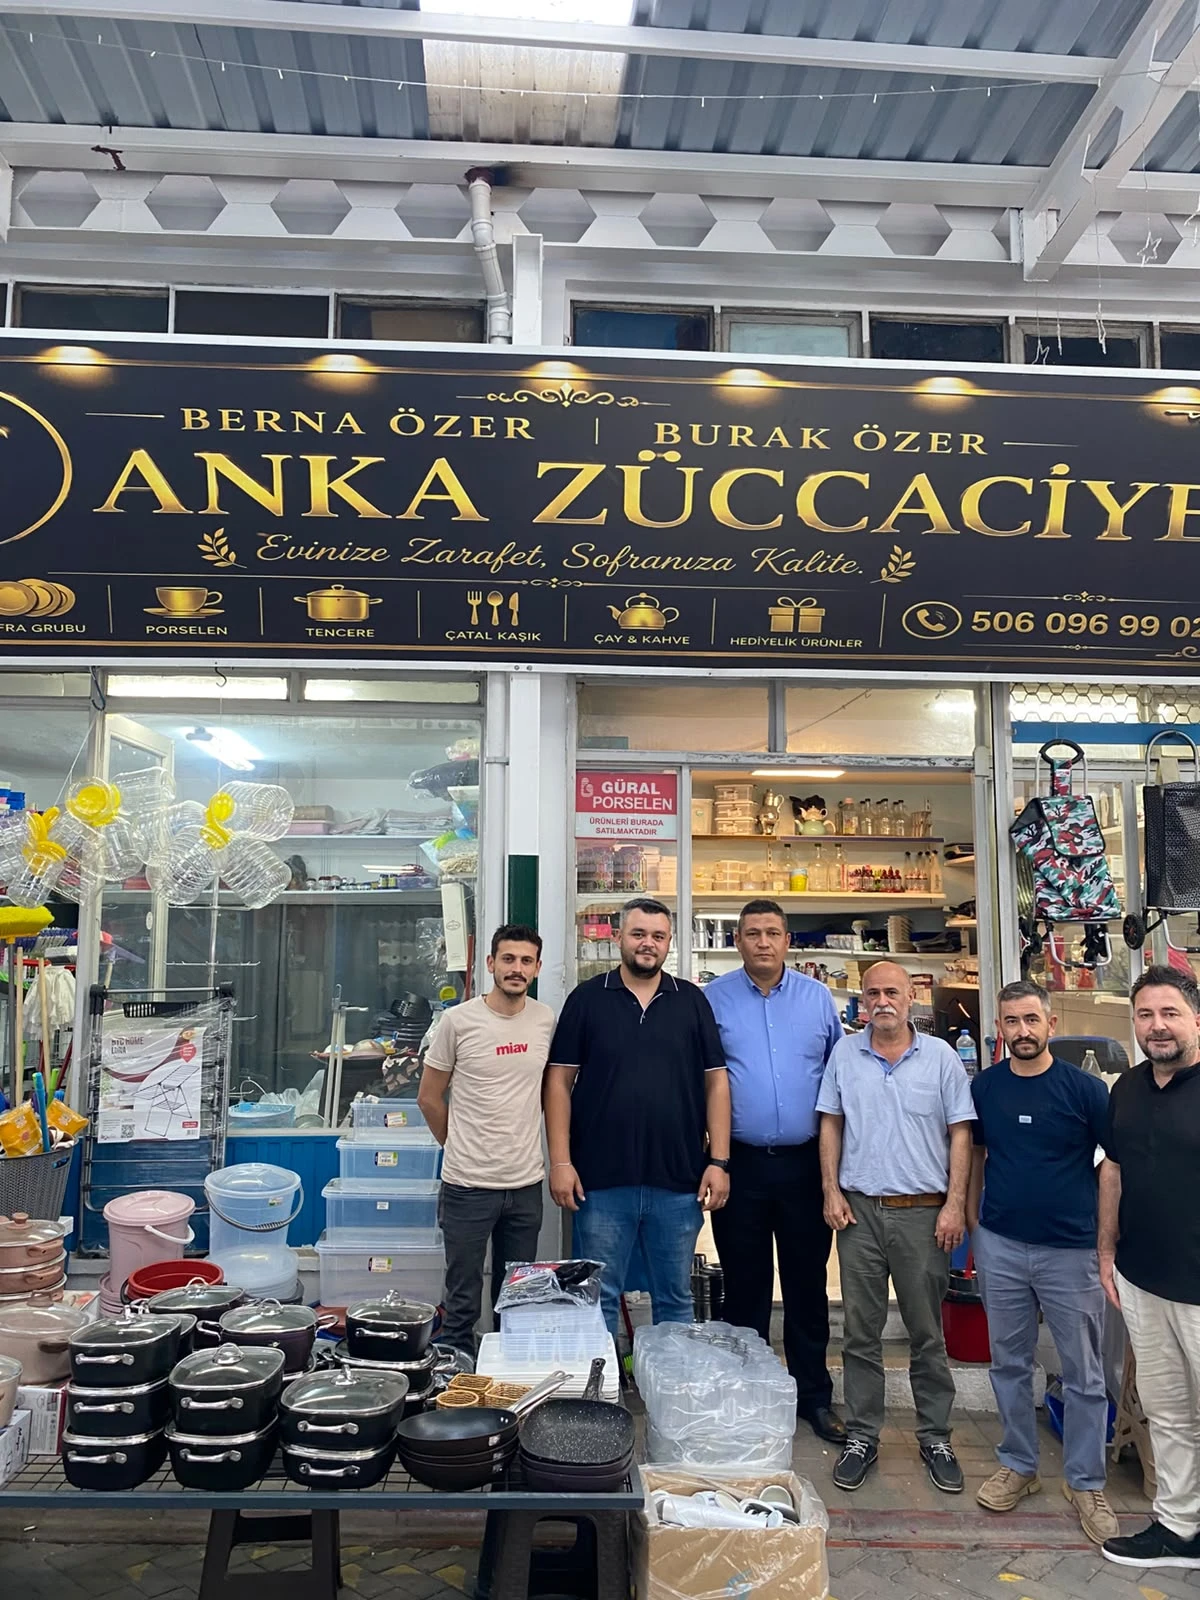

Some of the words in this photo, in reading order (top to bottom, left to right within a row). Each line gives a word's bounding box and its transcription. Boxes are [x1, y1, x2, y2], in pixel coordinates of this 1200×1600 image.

[181, 407, 366, 435] BERNA
[390, 407, 535, 440] ÖZER
[654, 422, 831, 450] BURAK
[853, 423, 988, 456] ÖZER
[93, 449, 490, 521] ANKA
[532, 450, 1200, 542] ZÜCCACİYE
[256, 532, 391, 563] Evinize
[401, 537, 547, 574] Zarafet,
[562, 542, 737, 577] Sofranıza
[751, 547, 863, 576] Kalite.
[31, 623, 86, 633] GRUBU
[145, 625, 228, 635] PORSELEN
[971, 610, 1035, 633] 506
[1045, 612, 1109, 635] 096
[1119, 614, 1160, 637] 99
[305, 627, 375, 638] TENCERE
[445, 630, 493, 641] ÇATAL
[497, 631, 541, 643] KAŞIK
[593, 634, 624, 645] ÇAY
[627, 635, 638, 644] &
[642, 635, 690, 645] KAHVE
[730, 635, 798, 647] HEDİYELİK
[801, 637, 863, 648] ÜRÜNLER
[601, 779, 661, 795] GÜRAL
[592, 796, 673, 811] PORSELEN
[589, 816, 628, 826] ÜRÜNLERİ
[630, 818, 664, 826] BURADA
[595, 827, 657, 836] SATILMAKTADIR
[496, 1042, 528, 1056] miav
